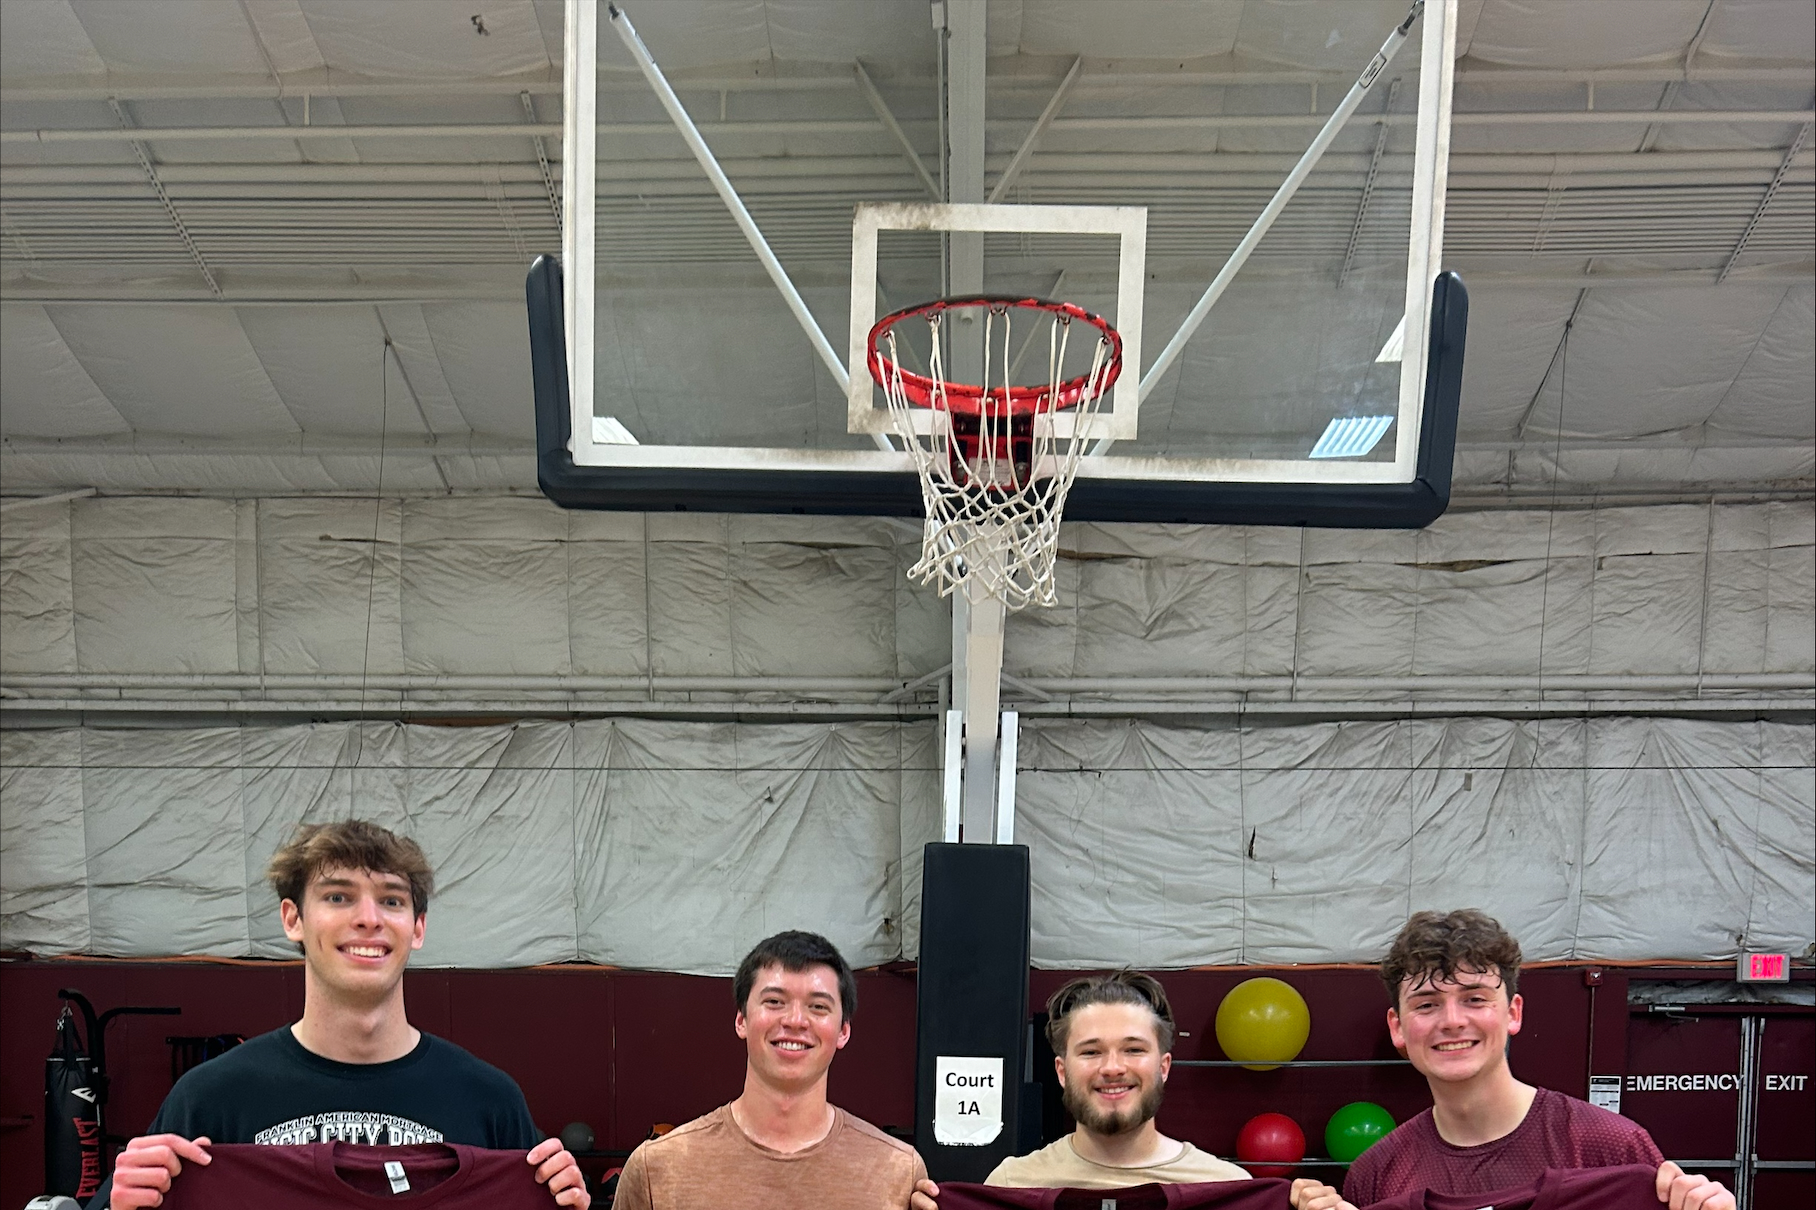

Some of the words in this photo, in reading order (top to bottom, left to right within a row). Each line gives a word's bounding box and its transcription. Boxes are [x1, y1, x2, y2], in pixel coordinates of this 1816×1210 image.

[1750, 954, 1785, 979] EXIT
[945, 1072, 994, 1088] Court
[1626, 1075, 1744, 1091] EMERGENCY
[1765, 1075, 1808, 1091] EXIT
[958, 1100, 981, 1115] 1A
[255, 1115, 315, 1143] FRANKLIN
[315, 1111, 380, 1125] AMERICAN
[381, 1113, 443, 1143] MORTGAGE
